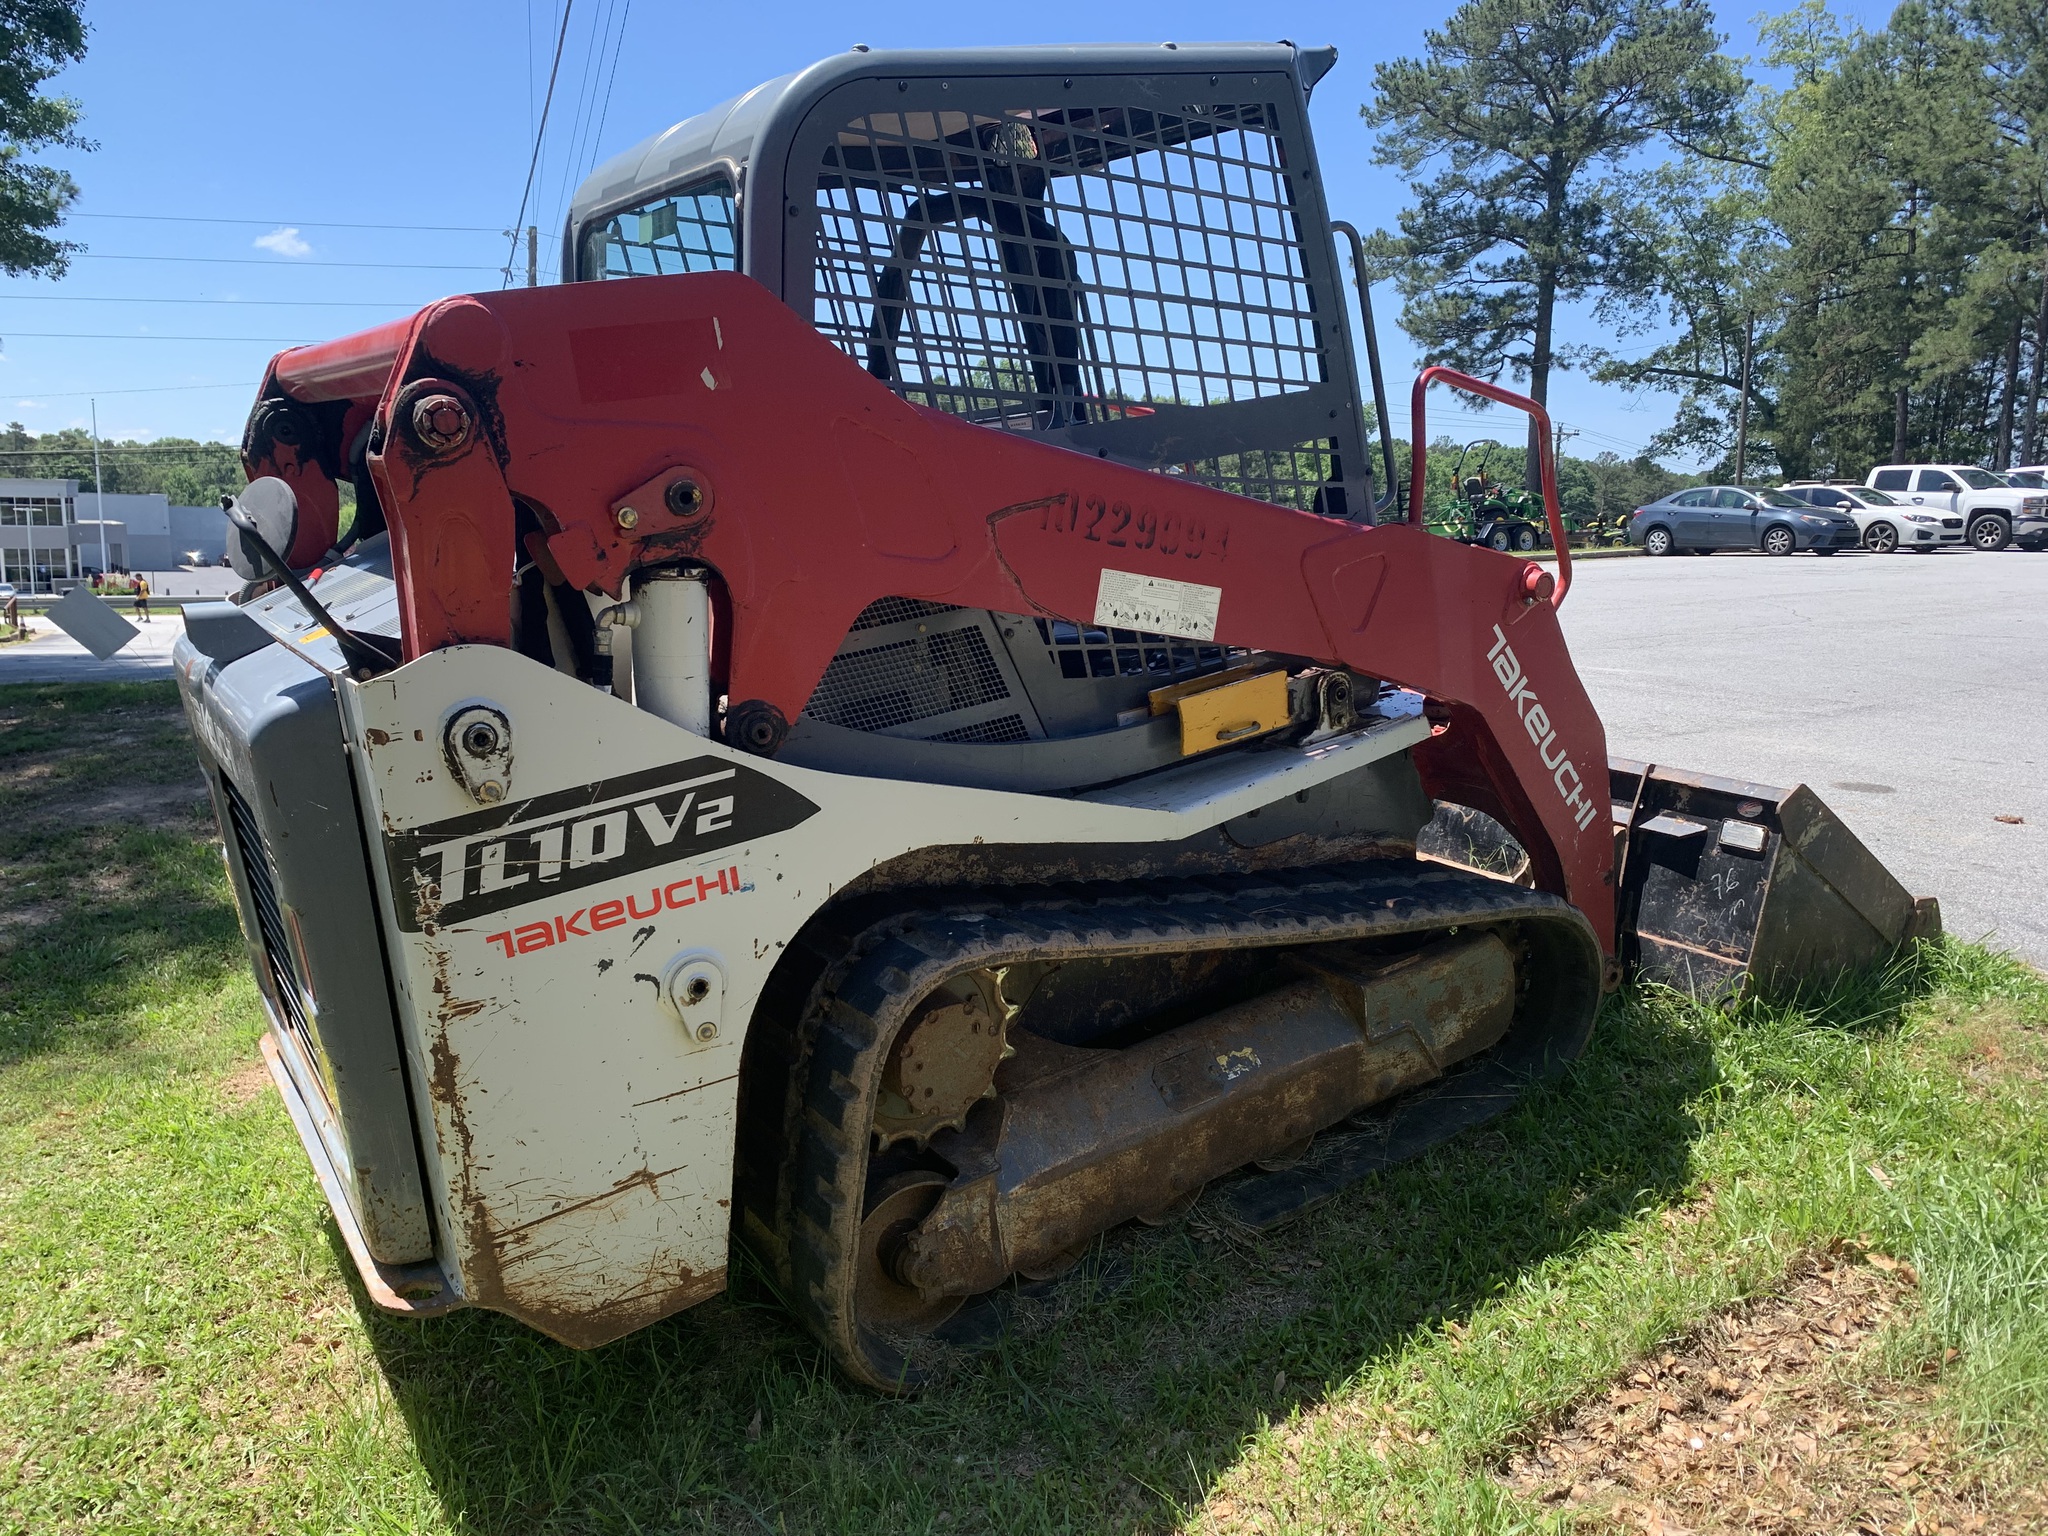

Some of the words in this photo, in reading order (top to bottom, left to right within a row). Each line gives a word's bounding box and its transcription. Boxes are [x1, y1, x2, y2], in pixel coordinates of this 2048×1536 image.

[1486, 623, 1598, 832] TAKEUCHI
[419, 780, 737, 905] TL10V2
[485, 866, 741, 959] TAKEUCHI
